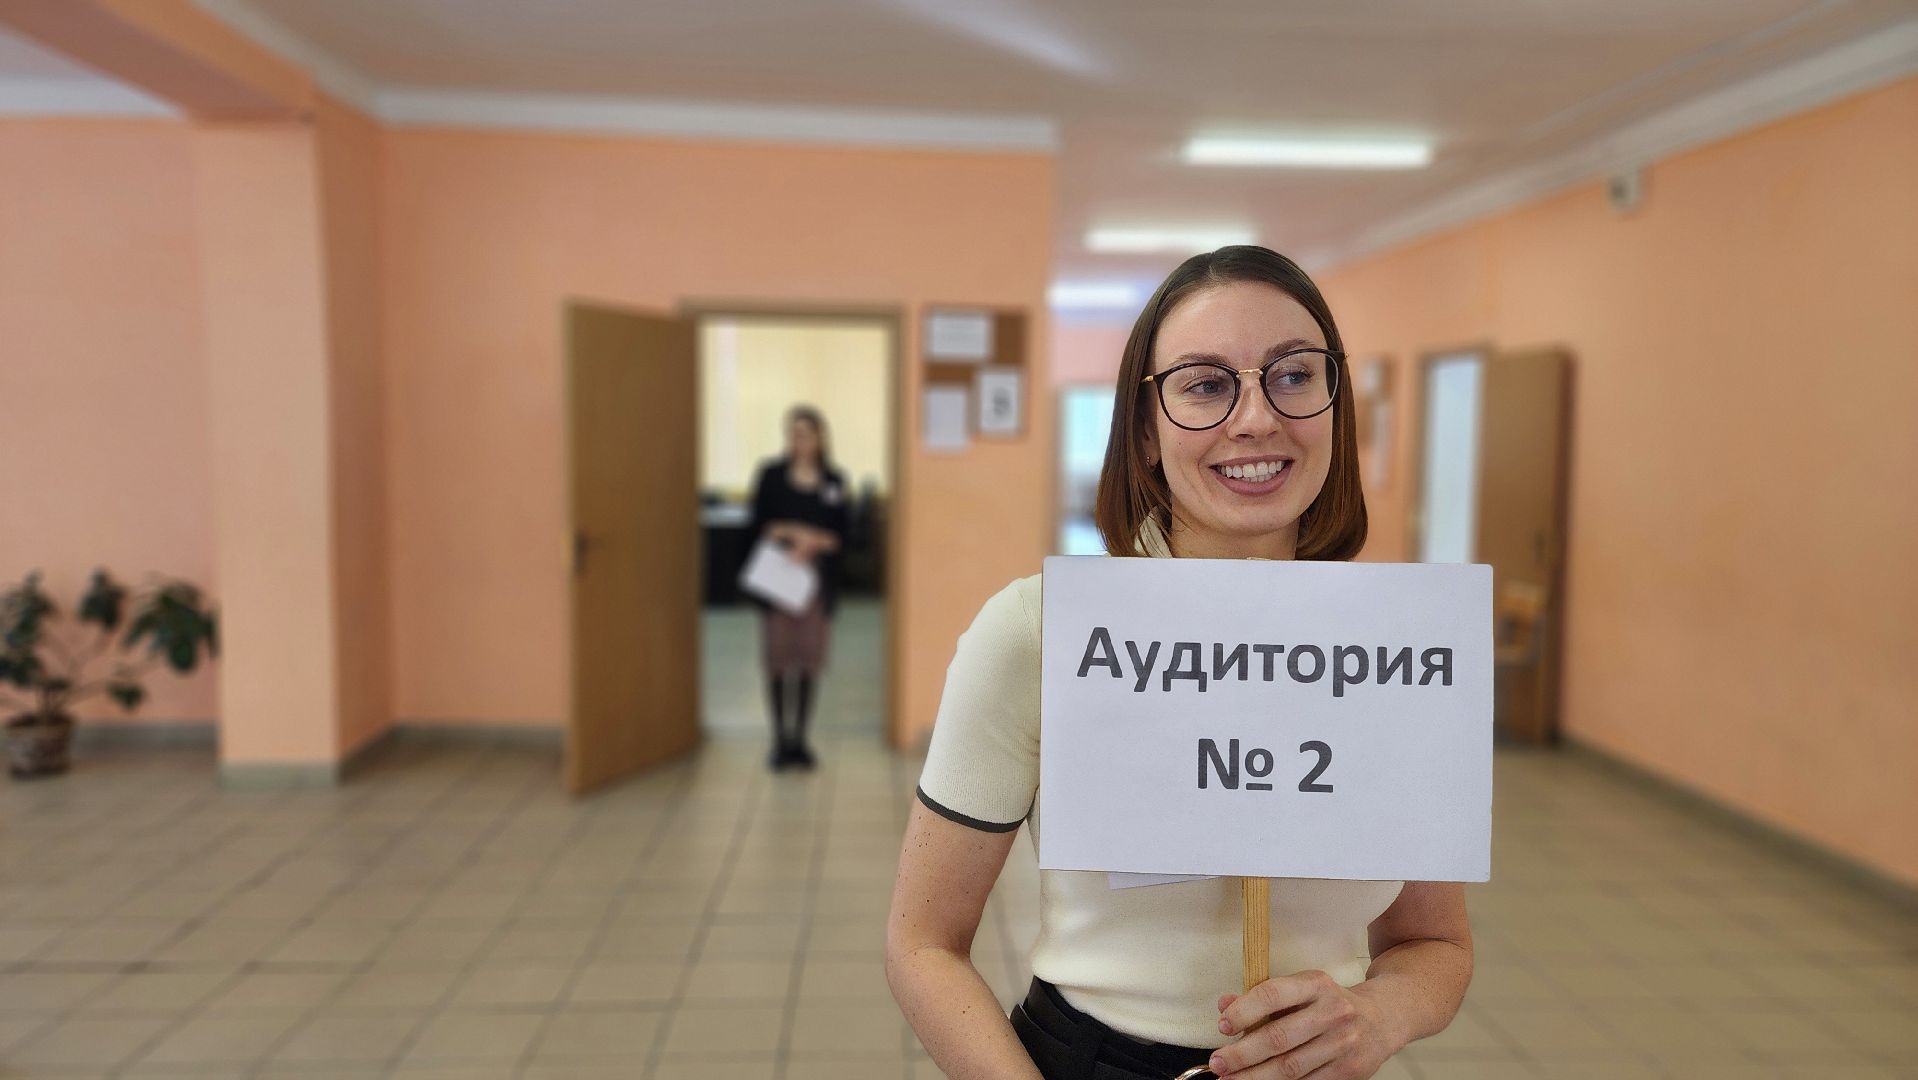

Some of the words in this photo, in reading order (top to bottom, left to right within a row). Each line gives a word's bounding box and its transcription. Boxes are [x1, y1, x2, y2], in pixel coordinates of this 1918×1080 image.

[1077, 627, 1453, 697] Аудитория
[1198, 739, 1274, 792] №
[1298, 741, 1334, 793] 2
